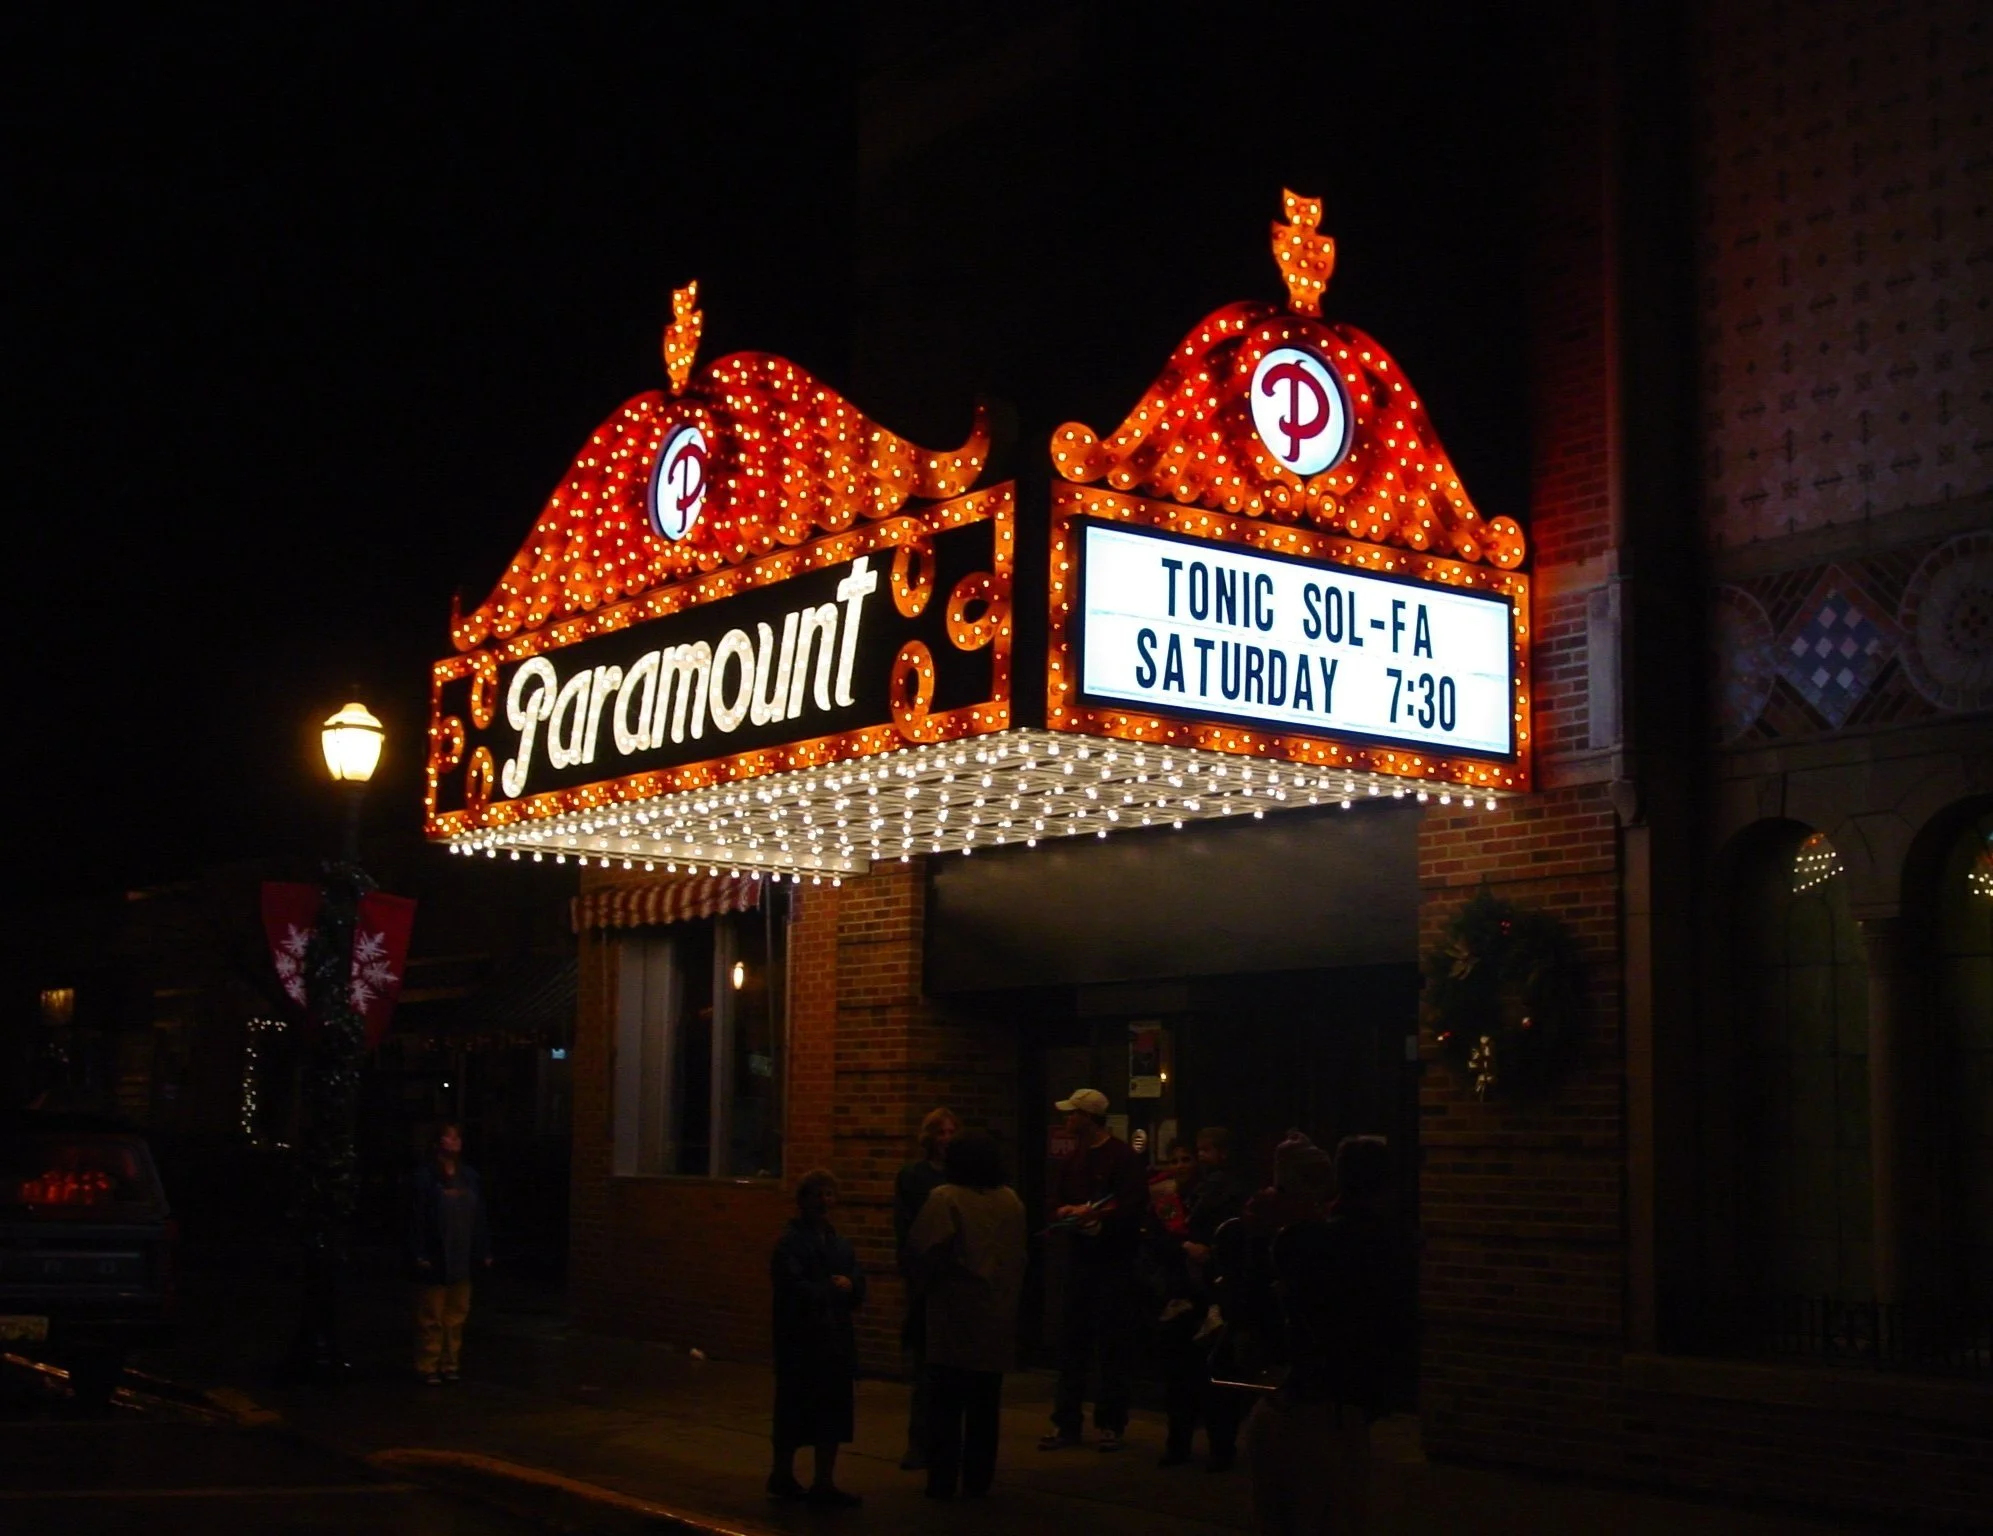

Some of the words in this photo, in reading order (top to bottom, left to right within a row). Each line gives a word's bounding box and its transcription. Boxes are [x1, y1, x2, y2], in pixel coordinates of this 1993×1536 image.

[1261, 359, 1330, 463] P
[1161, 557, 1274, 632] TONIC
[1302, 582, 1433, 659] SOL-FA
[502, 556, 877, 798] Paramount
[1135, 627, 1339, 714] SATURDAY
[1386, 667, 1456, 732] 7:30
